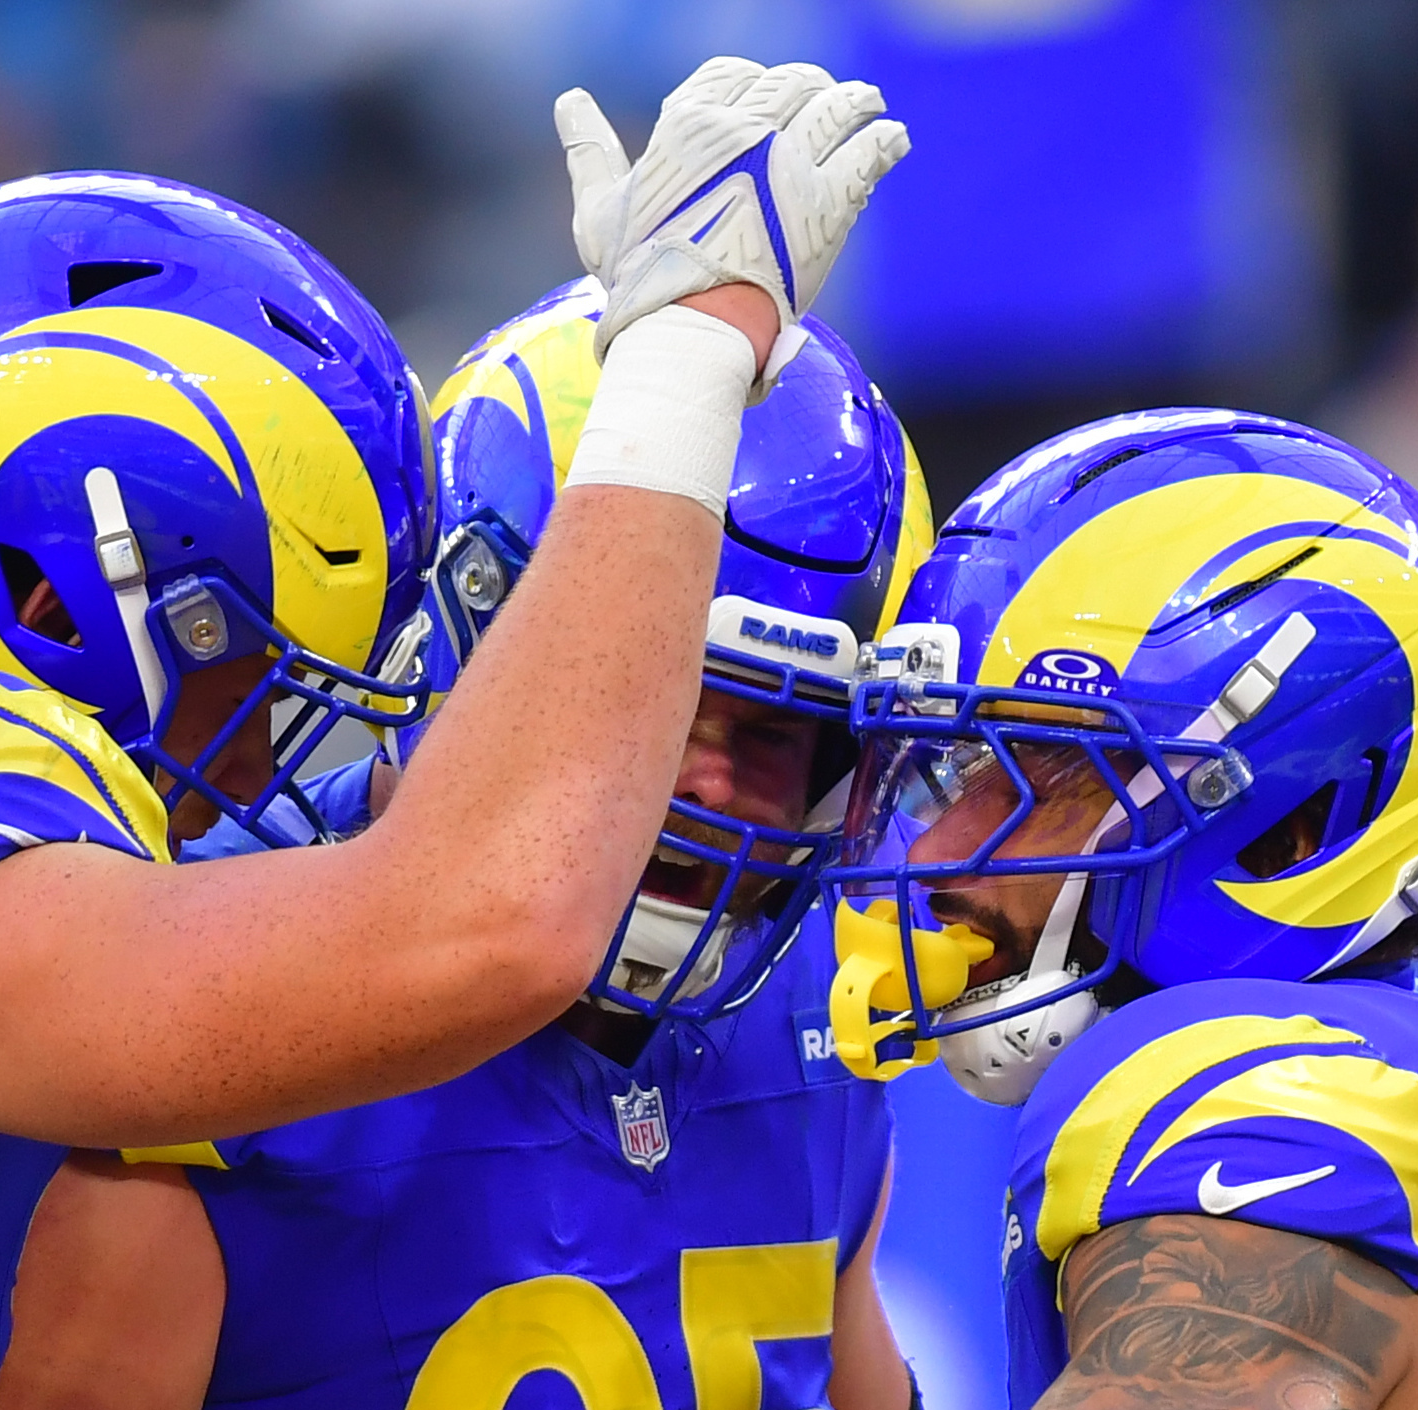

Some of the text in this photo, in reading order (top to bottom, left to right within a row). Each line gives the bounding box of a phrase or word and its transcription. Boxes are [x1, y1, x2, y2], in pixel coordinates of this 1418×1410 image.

[740, 615, 840, 658] RAMS
[1024, 672, 1113, 697] OAKLEY
[802, 1026, 839, 1061] RA
[627, 1121, 662, 1155] NFL
